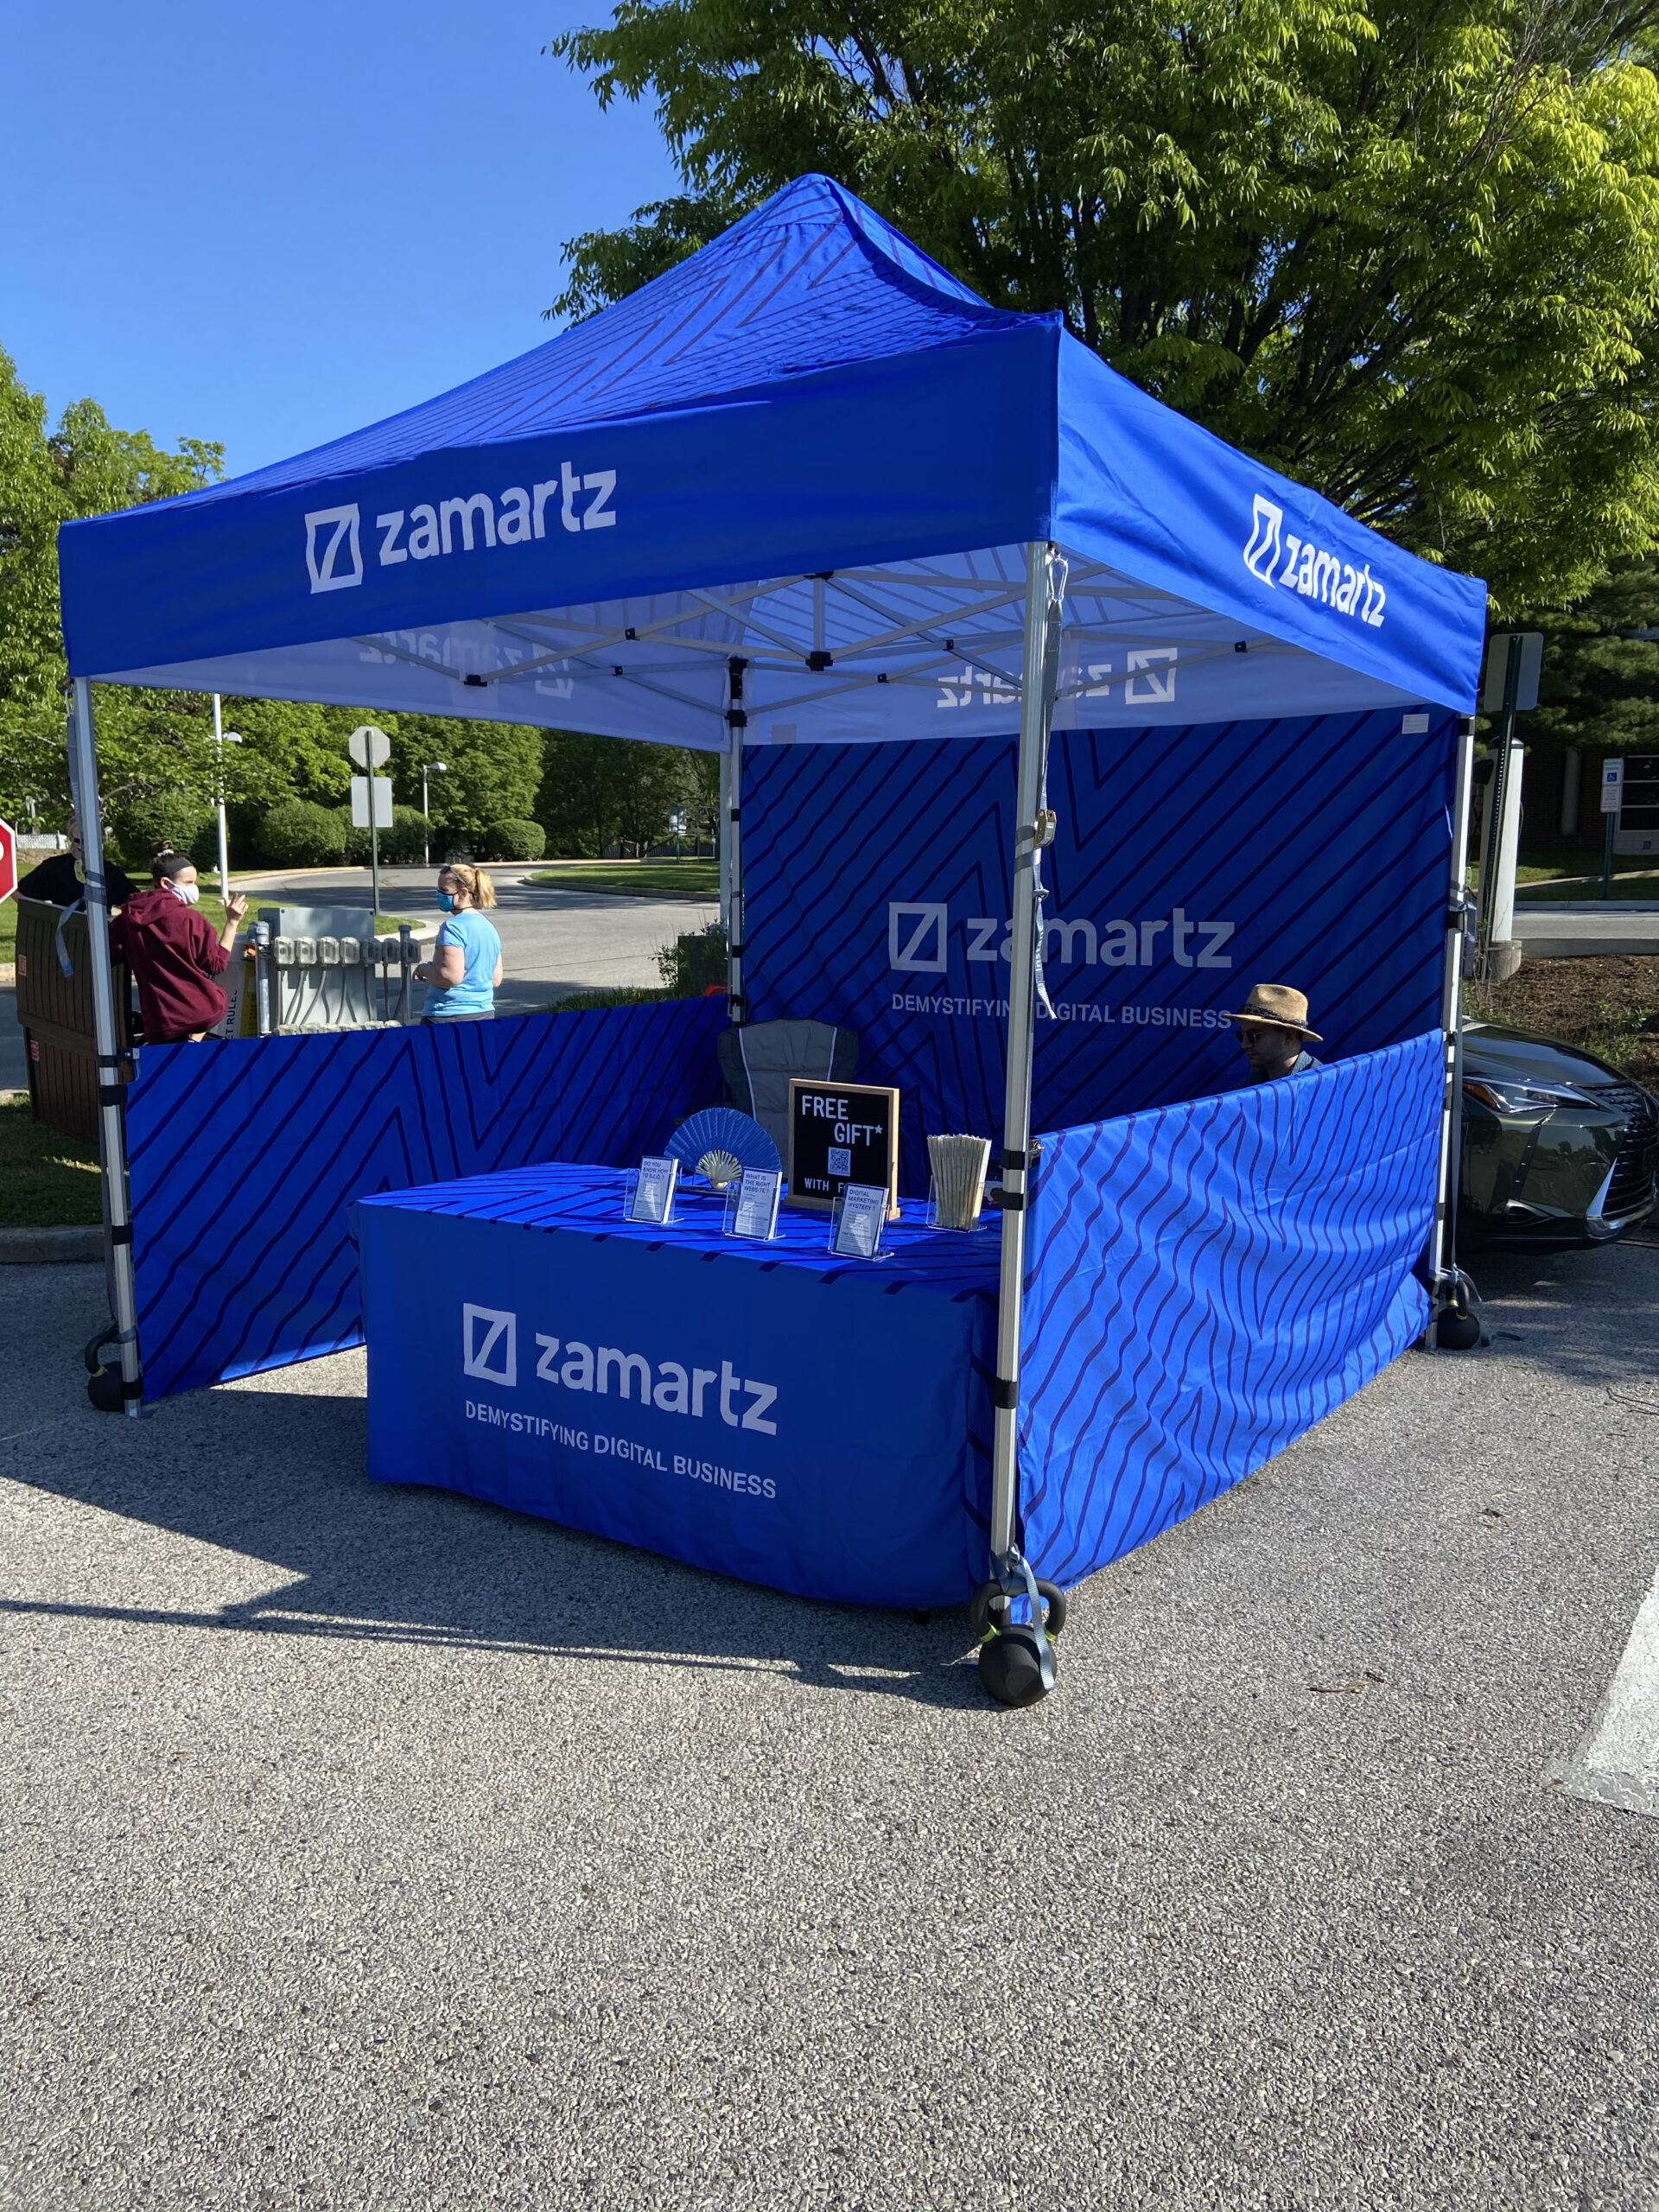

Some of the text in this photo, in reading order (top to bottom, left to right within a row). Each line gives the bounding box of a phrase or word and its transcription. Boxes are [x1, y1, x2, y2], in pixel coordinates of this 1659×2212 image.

[376, 461, 616, 566] zamartz
[1279, 533, 1386, 627] zamartz
[226, 989, 238, 1025] RULE
[892, 994, 1010, 1017] DEMYSTIFYIN
[1122, 1006, 1231, 1028] BUSINESS
[802, 1095, 849, 1121] FREE
[804, 1177, 830, 1192] WITH
[849, 1189, 870, 1198] DIGITAL
[536, 1332, 778, 1436] zamartz
[466, 1400, 777, 1499] DEMYSTIFYING DIGITAL BUSINESS
